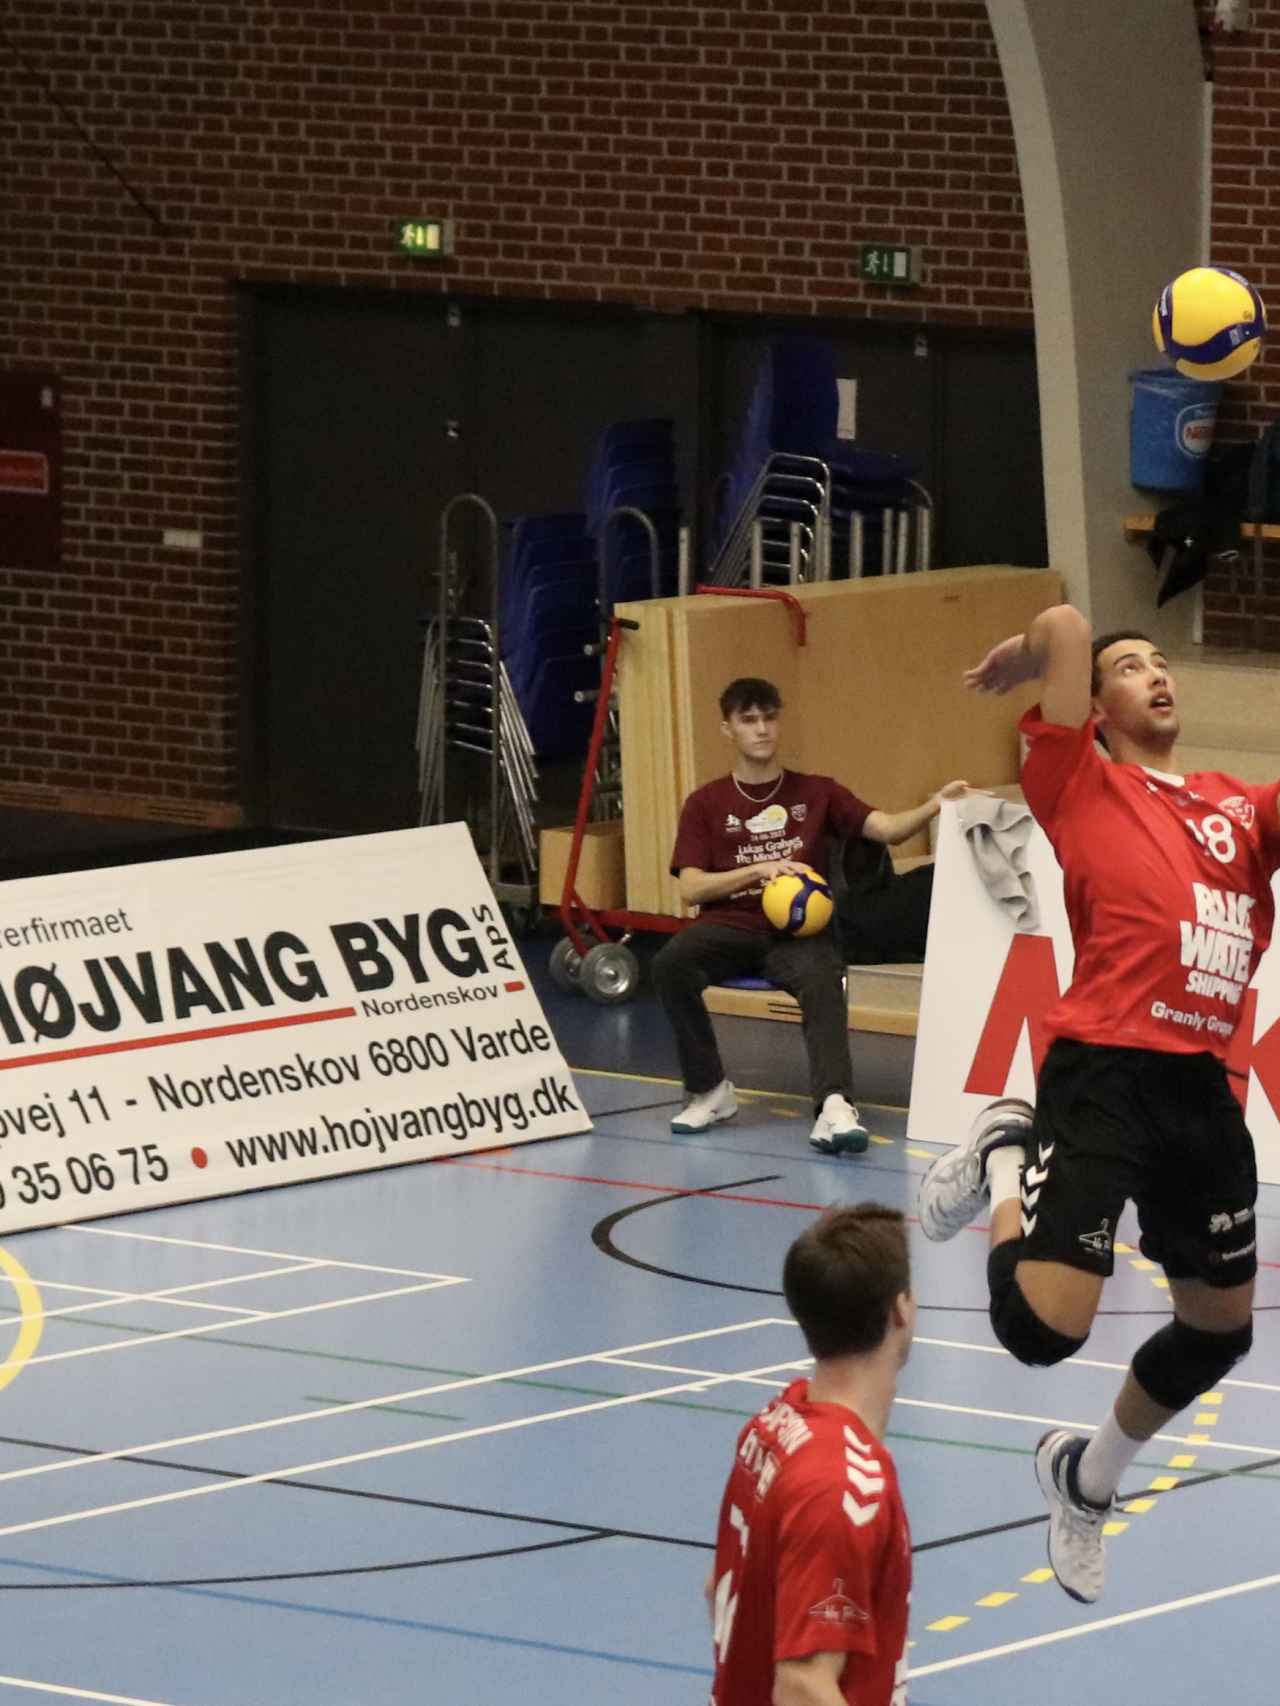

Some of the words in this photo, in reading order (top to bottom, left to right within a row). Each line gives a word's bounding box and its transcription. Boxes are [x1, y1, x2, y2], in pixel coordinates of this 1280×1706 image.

[329, 908, 489, 993] BYG
[1180, 920, 1253, 983] WATE
[361, 984, 499, 1018] Nordenskov
[1151, 1001, 1206, 1031] Granly
[68, 1085, 110, 1125] 11
[147, 1053, 361, 1112] Nordenskov
[368, 1032, 450, 1077] 6800
[450, 1018, 551, 1062] Varde
[11, 1161, 61, 1205] 35
[66, 1153, 114, 1195] 06
[117, 1144, 168, 1185] 75
[225, 1076, 579, 1168] www.hojvangbyg.dk
